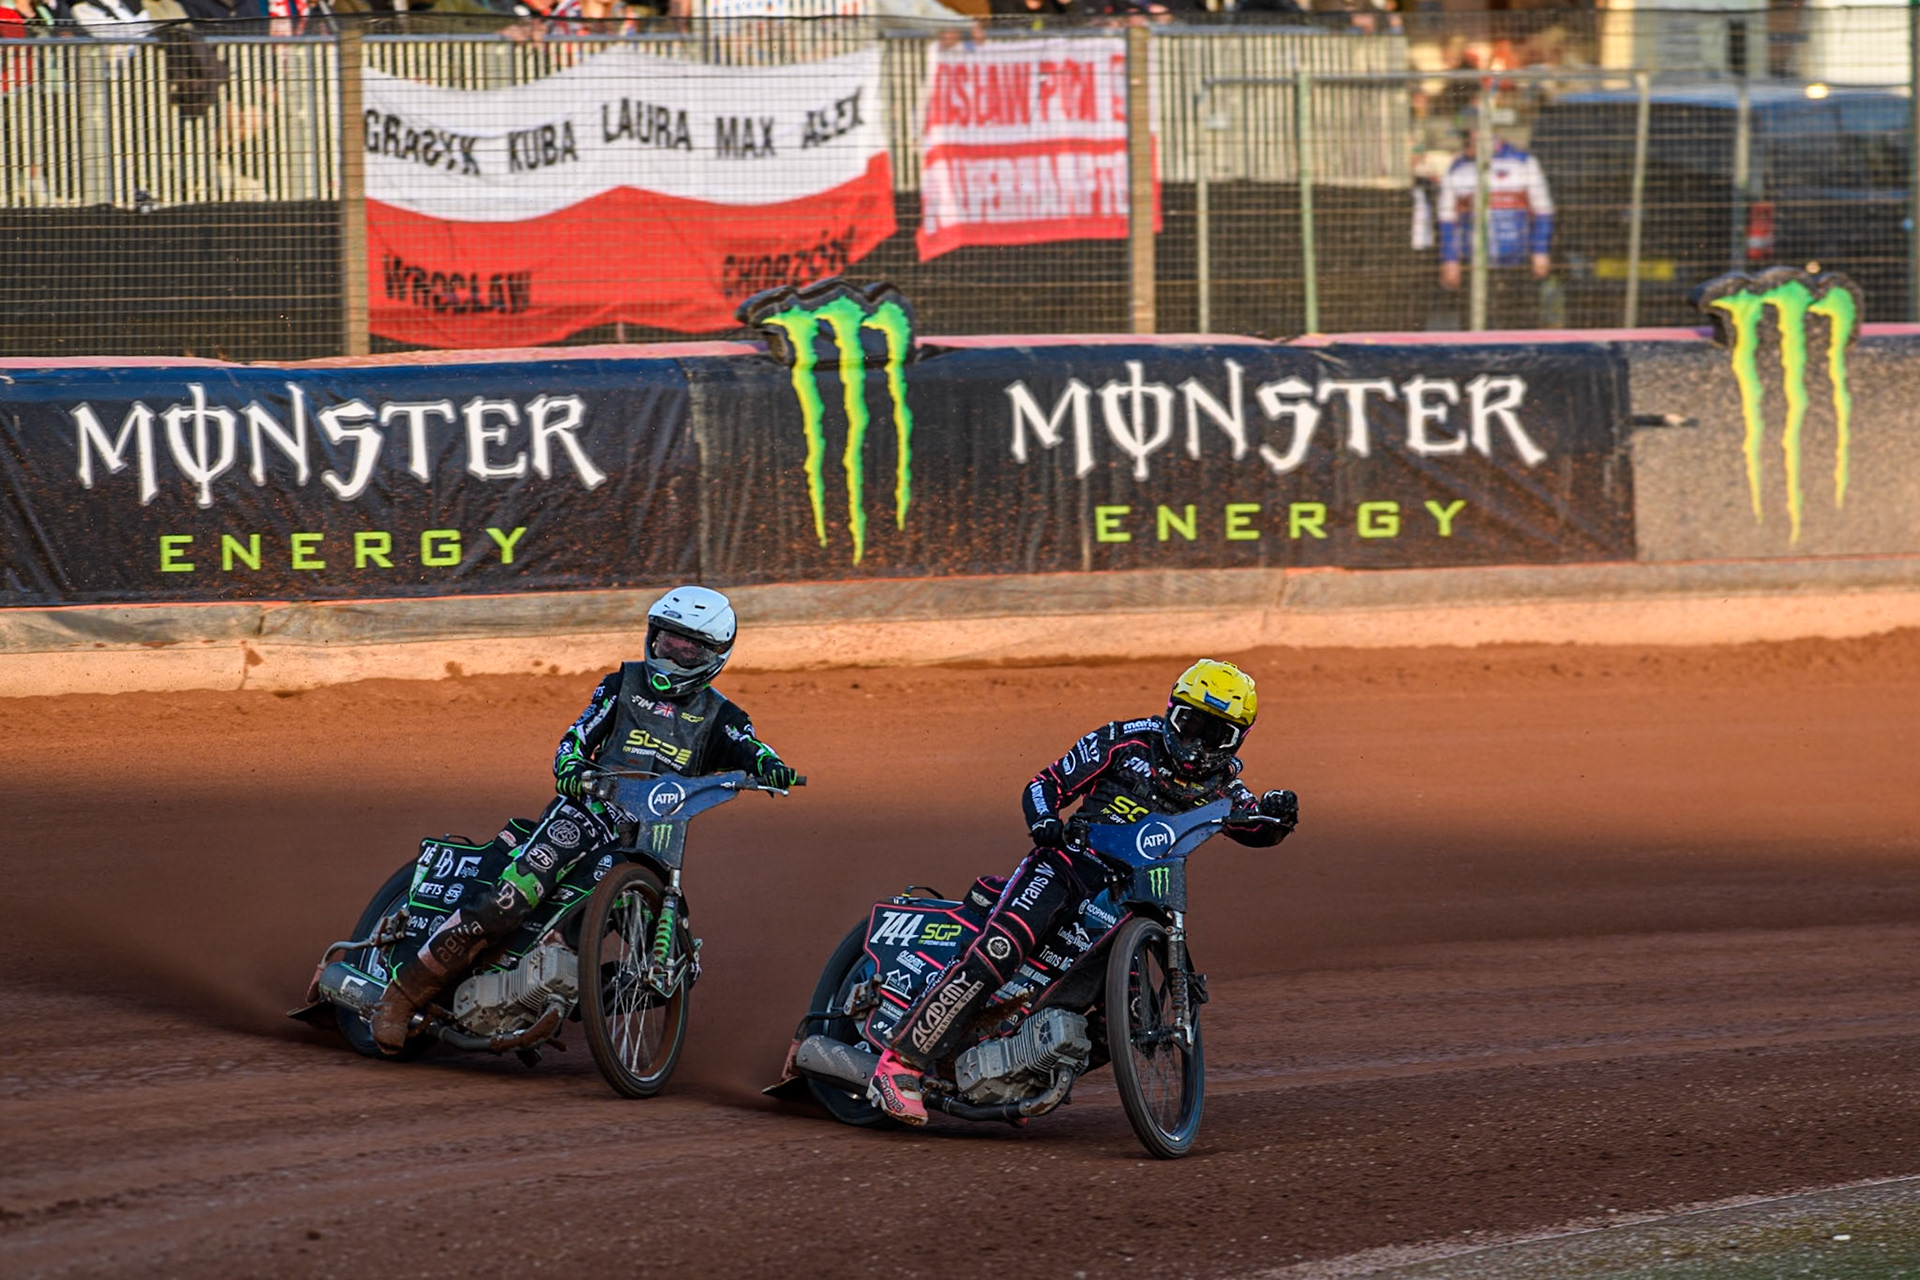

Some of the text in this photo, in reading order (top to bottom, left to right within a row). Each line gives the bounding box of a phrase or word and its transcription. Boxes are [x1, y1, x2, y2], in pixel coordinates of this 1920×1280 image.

[508, 120, 578, 172] KUBA
[602, 97, 692, 151] LAURA
[716, 116, 776, 159] MAX
[1006, 359, 1547, 482] MONSTER
[70, 382, 607, 508] MONSTER
[1095, 500, 1466, 543] ENERGY
[160, 526, 528, 573] ENERGY
[631, 694, 656, 710] FIM
[1123, 756, 1152, 778] FIM
[653, 793, 679, 805] ATPI
[1142, 833, 1168, 848] ATPI
[426, 884, 445, 895] FTS
[1011, 876, 1049, 911] Trans
[869, 911, 925, 947] 744
[921, 923, 963, 941] SGP
[1039, 944, 1061, 967] Trans
[911, 971, 972, 1049] ACADEMY
